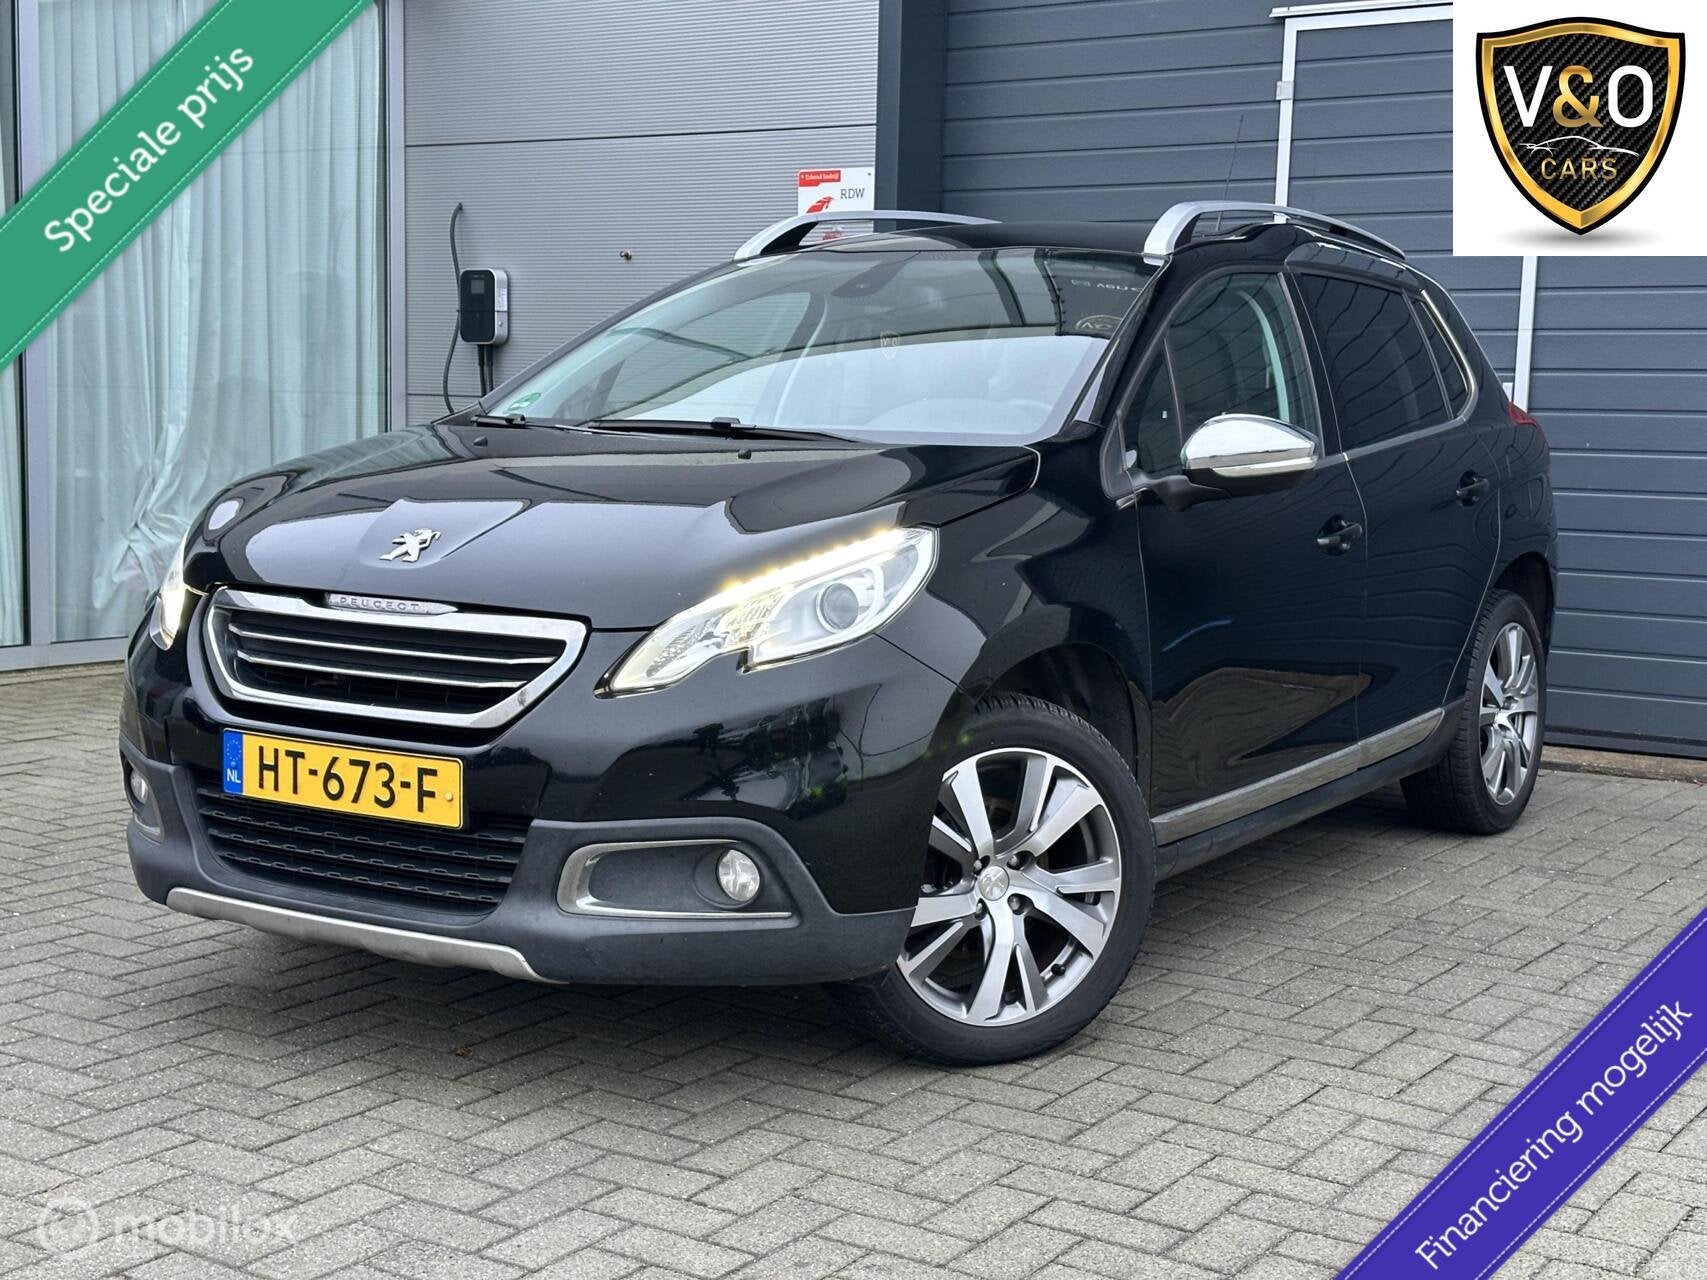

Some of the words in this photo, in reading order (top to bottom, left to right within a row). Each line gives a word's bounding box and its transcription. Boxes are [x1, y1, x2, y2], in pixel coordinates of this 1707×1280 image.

[840, 188, 865, 199] RDW
[340, 596, 419, 611] PEUGEOT
[227, 768, 241, 784] NL
[258, 745, 438, 813] HT-673-F
